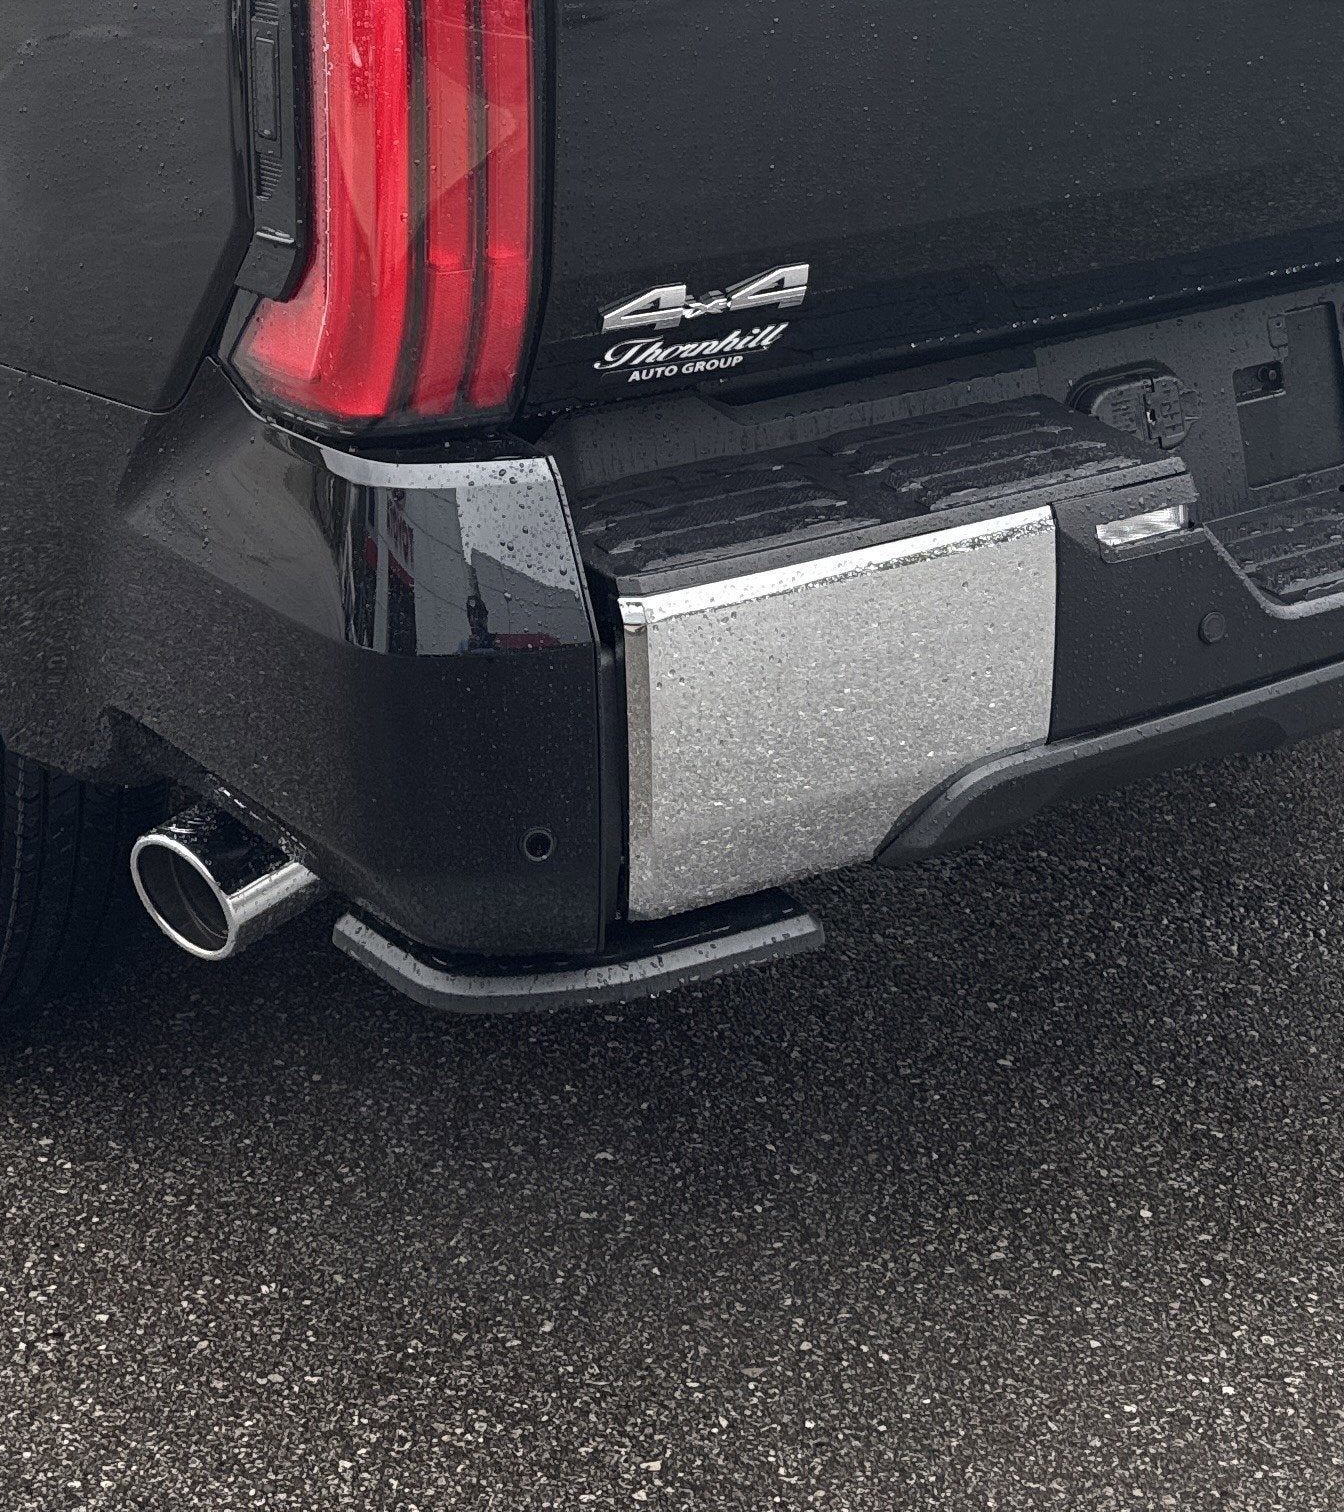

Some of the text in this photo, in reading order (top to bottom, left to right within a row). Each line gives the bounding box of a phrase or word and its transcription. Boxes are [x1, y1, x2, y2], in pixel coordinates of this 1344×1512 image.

[593, 321, 790, 370] Thornhill
[628, 355, 744, 383] AUTO GROUP
